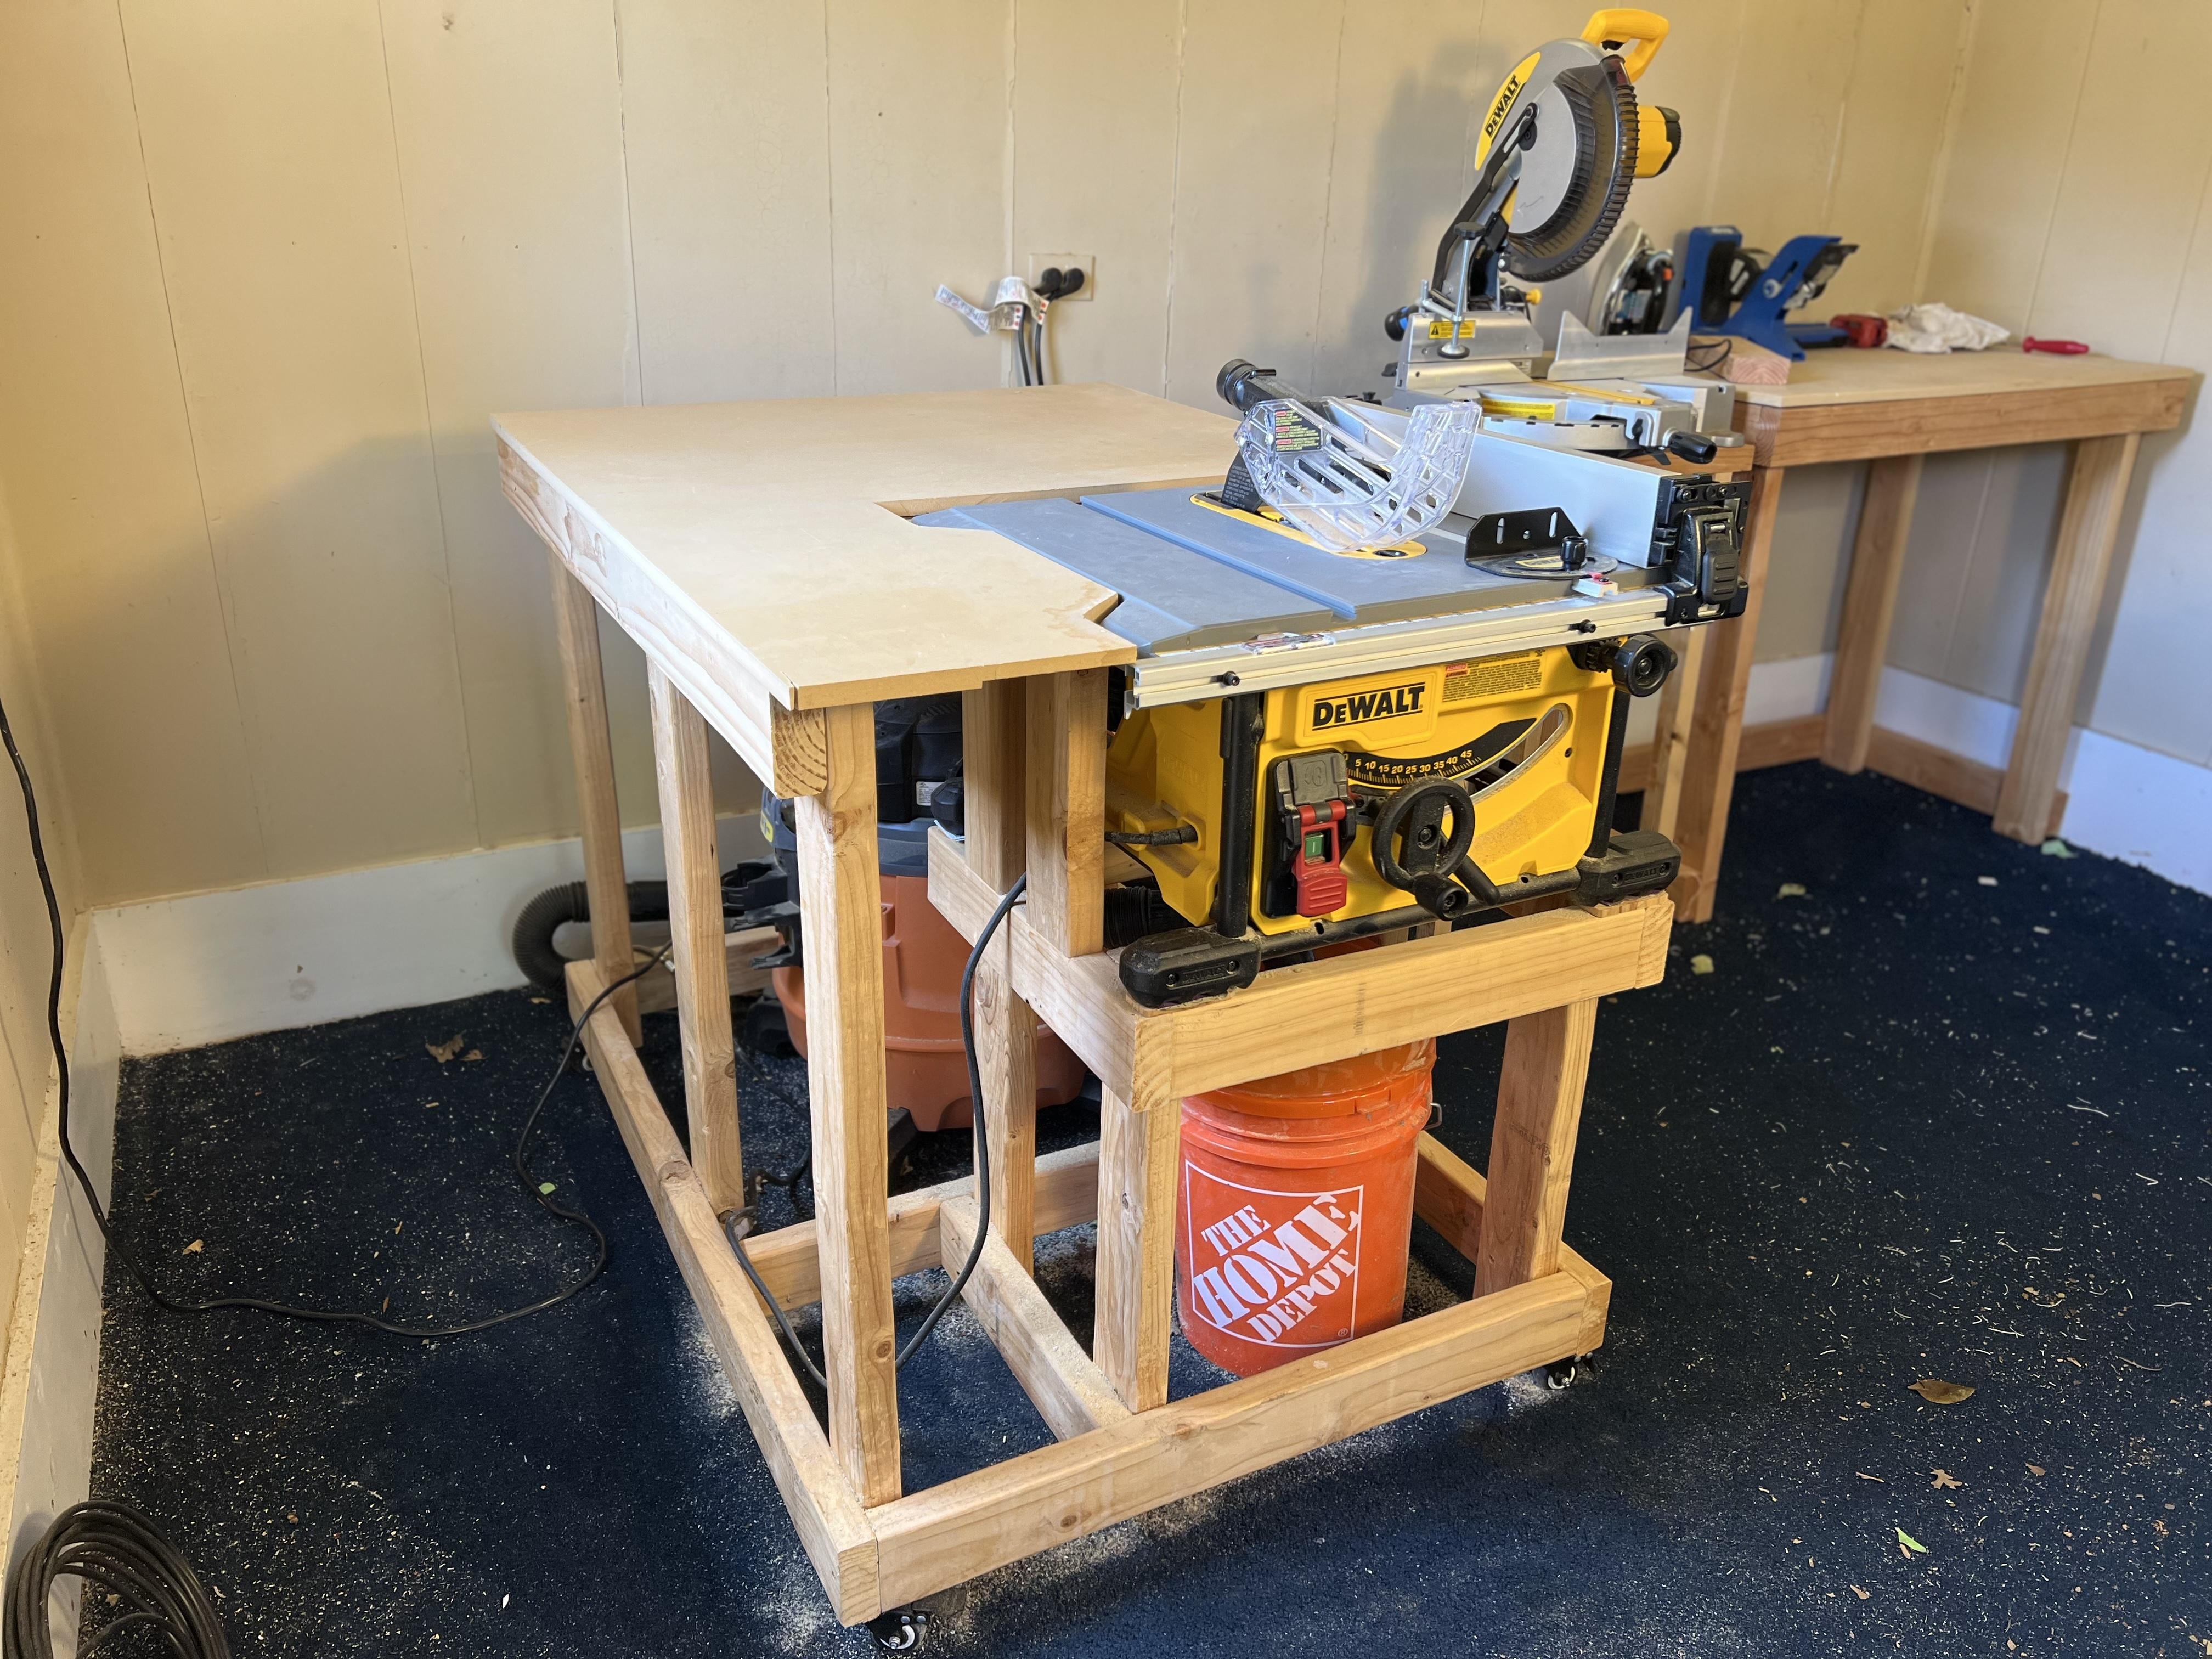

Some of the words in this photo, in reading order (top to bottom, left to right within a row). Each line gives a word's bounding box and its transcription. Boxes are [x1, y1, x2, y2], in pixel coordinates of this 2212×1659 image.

[1364, 761, 1376, 770] 10
[1379, 764, 1390, 773] 15
[1391, 765, 1403, 774] 20
[1405, 765, 1417, 774] 25
[1419, 764, 1431, 773] 30
[1433, 760, 1444, 769] 35
[1446, 756, 1458, 764] 40
[1460, 750, 1472, 759] 45
[1193, 1194, 1359, 1328] HOME
[1200, 1204, 1272, 1257] THE
[1246, 1248, 1356, 1343] DEPOT
